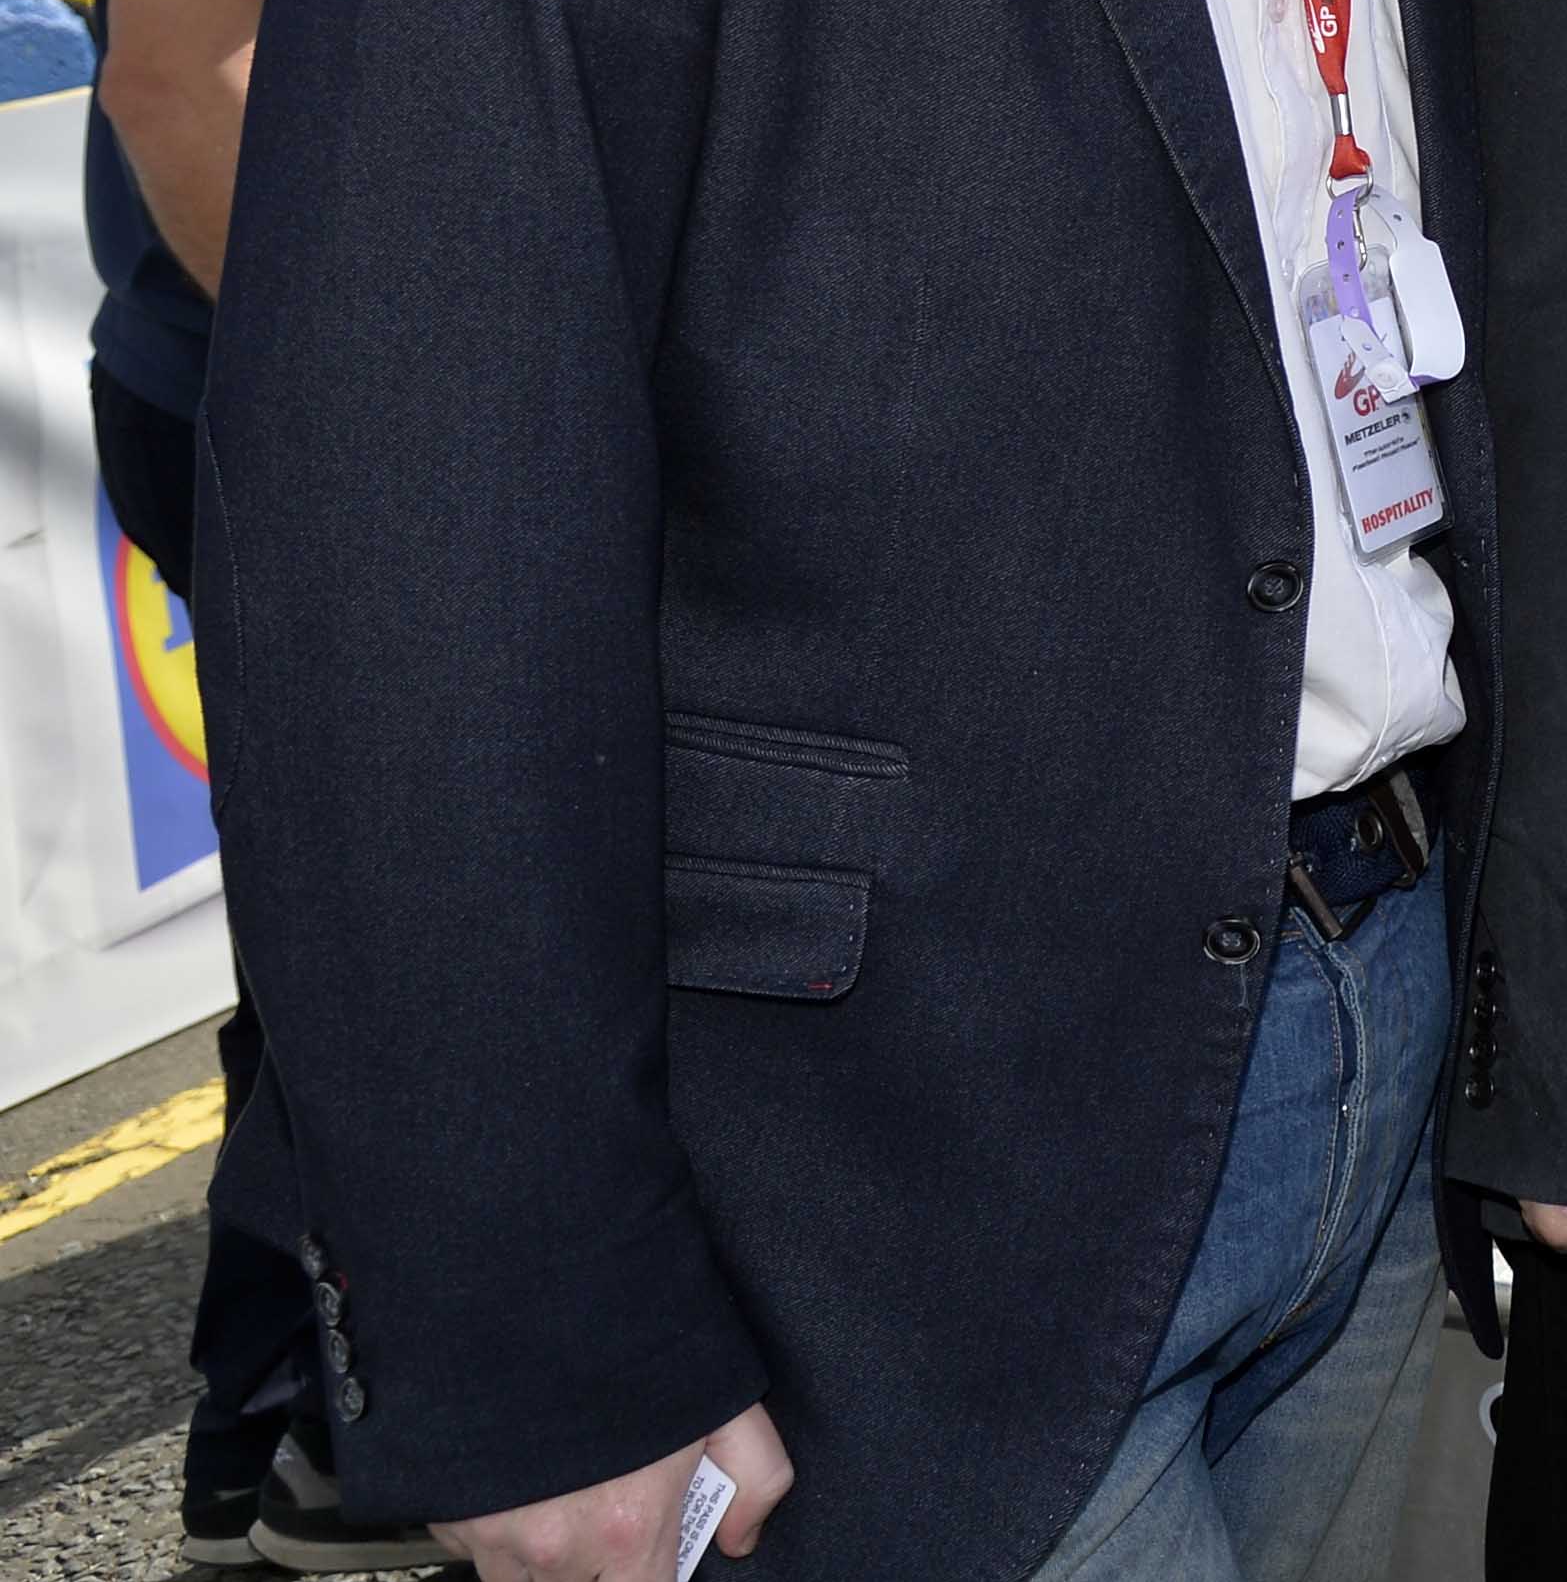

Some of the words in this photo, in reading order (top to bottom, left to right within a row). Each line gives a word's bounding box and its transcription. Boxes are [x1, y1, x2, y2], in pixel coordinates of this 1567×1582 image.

[1320, 5, 1338, 38] GP
[1353, 384, 1381, 416] GP
[1344, 414, 1401, 446] METZELER
[1360, 487, 1435, 535] HOSPITALITY
